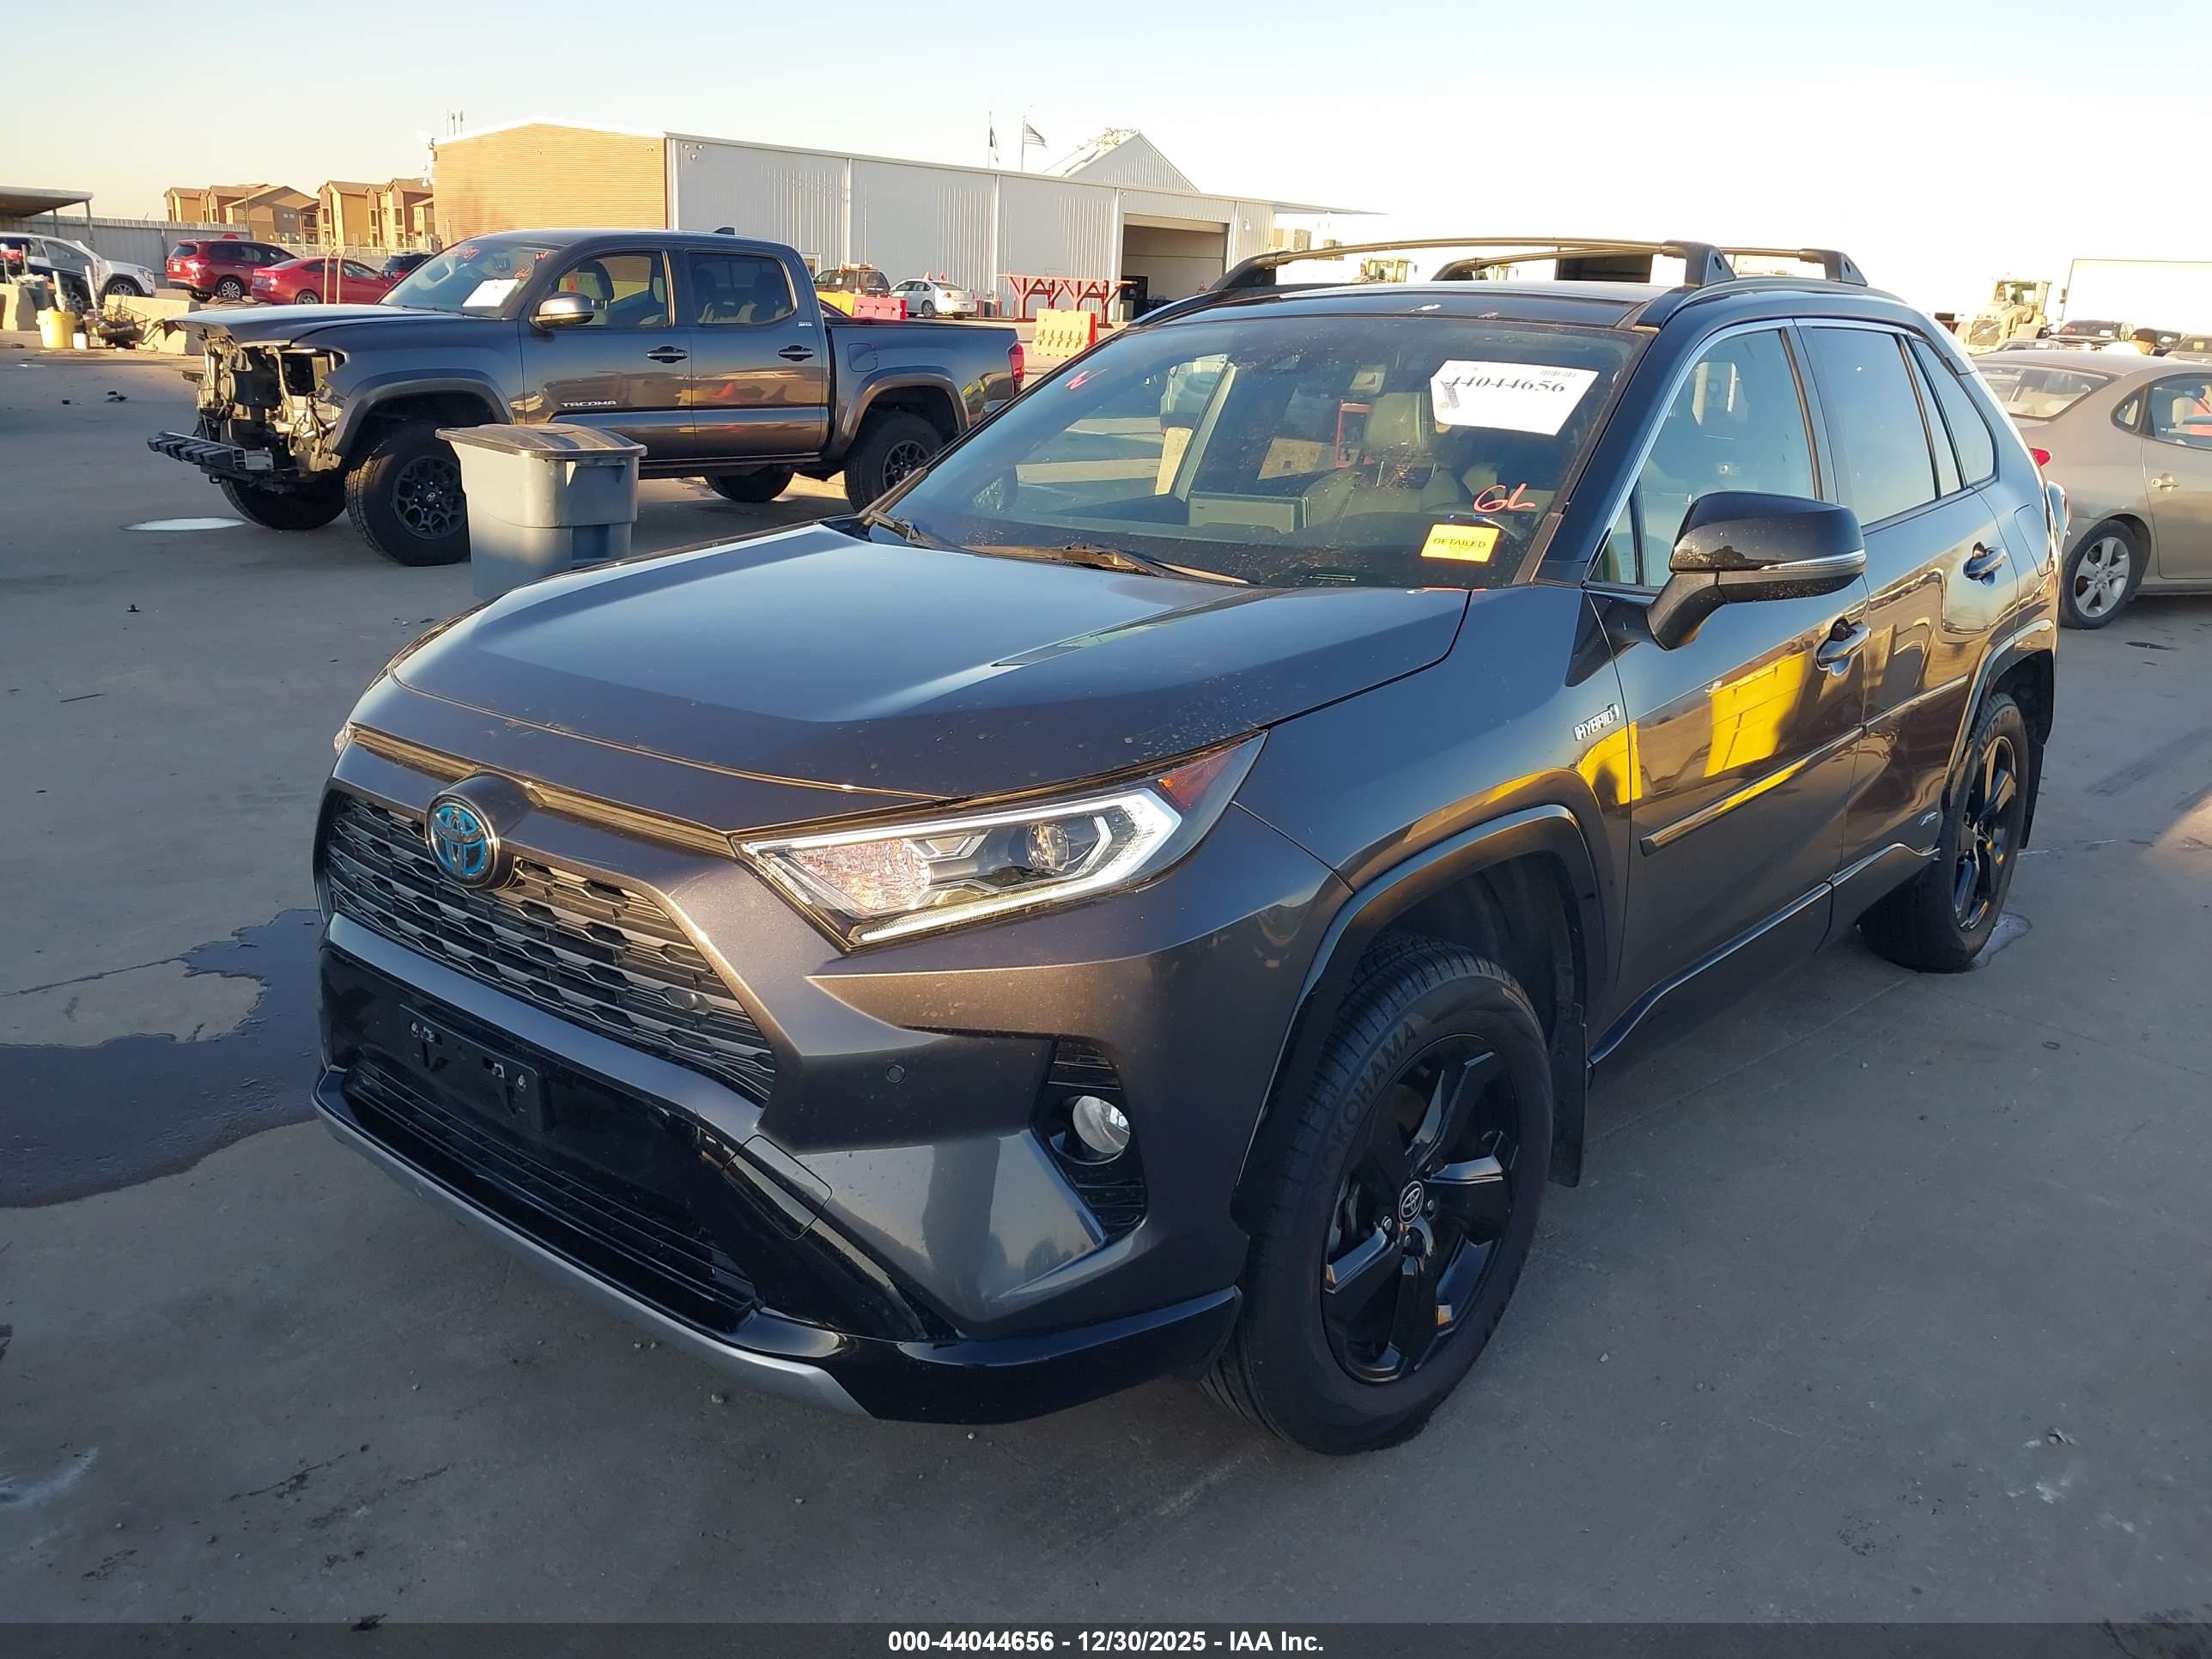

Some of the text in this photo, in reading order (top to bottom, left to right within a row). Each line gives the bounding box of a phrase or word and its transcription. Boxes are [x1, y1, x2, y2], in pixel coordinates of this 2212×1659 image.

[1443, 375, 1566, 392] 44044656
[1433, 538, 1486, 548] DETAILED
[1574, 706, 1616, 740] HYBRID
